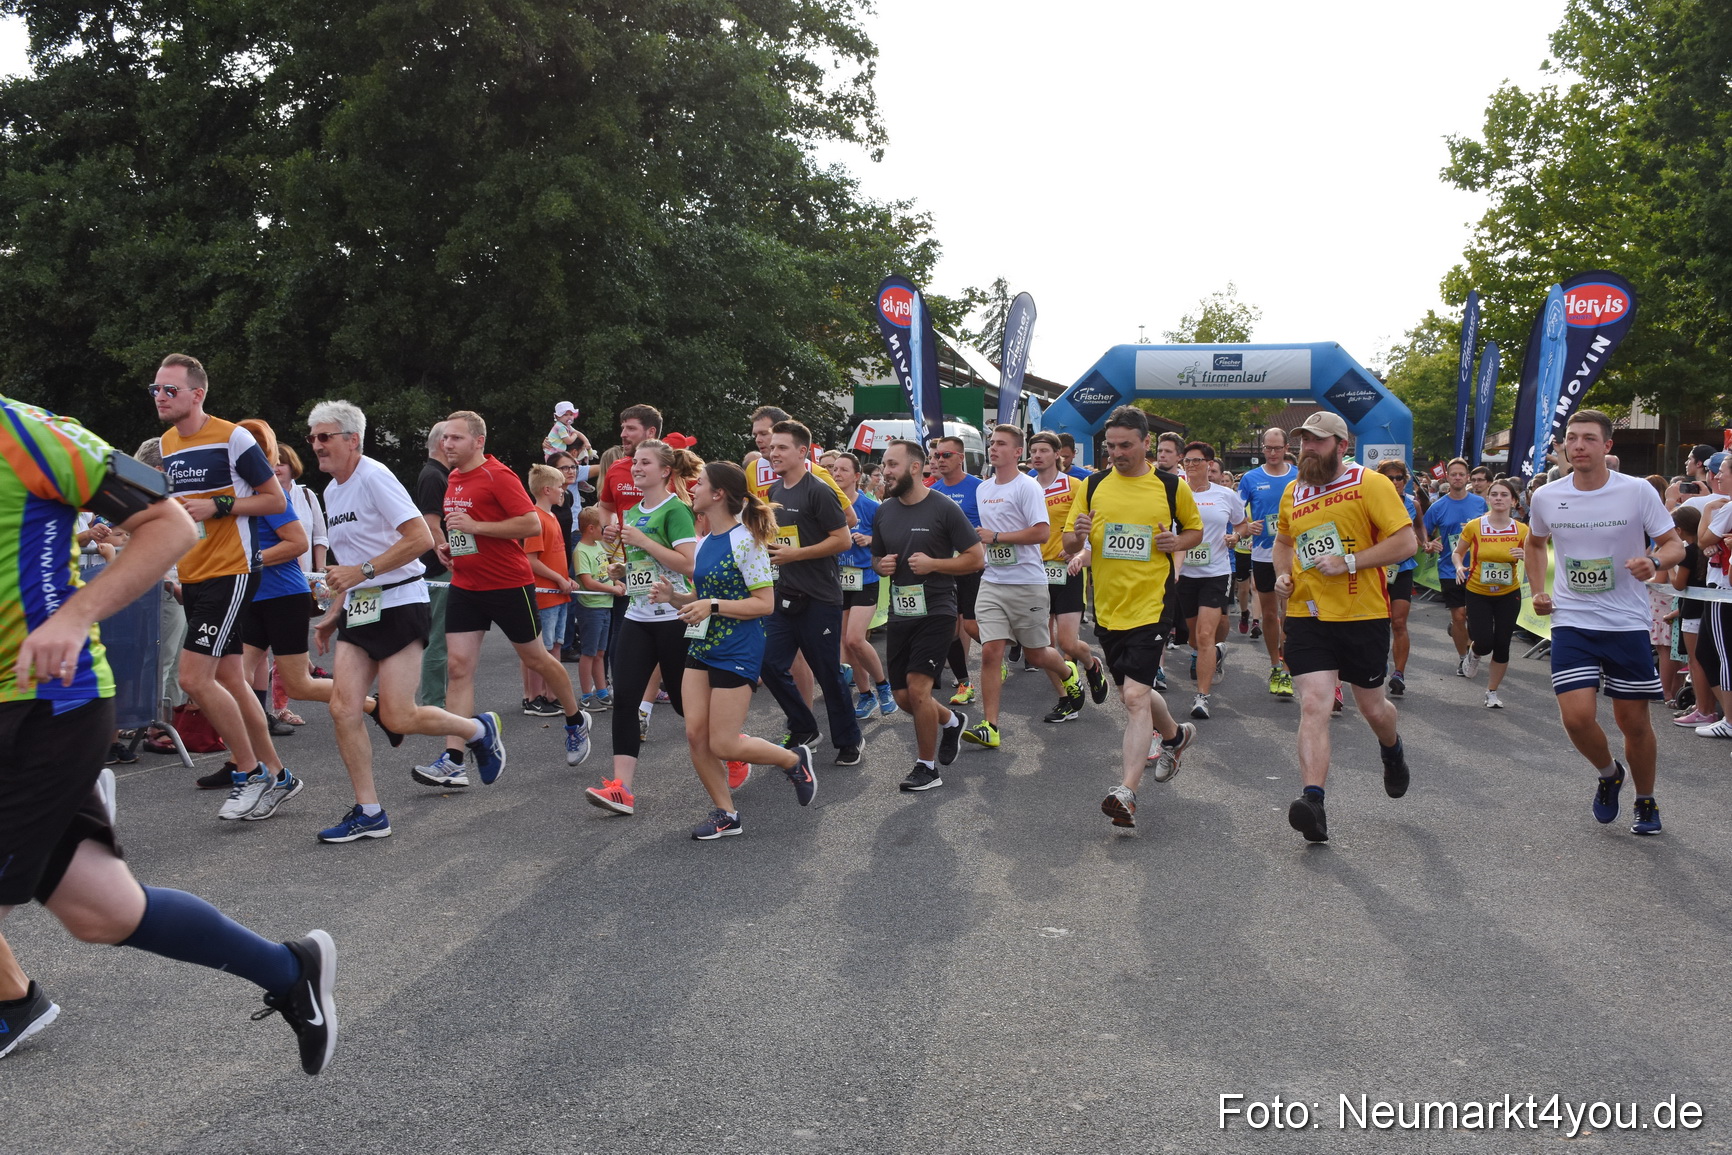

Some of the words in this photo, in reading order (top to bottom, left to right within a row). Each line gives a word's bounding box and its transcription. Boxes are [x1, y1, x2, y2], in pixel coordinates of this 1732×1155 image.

[1563, 294, 1624, 318] Hervis
[1202, 370, 1268, 383] firmenlauf
[1080, 393, 1115, 401] Fischer
[171, 467, 209, 479] Fischer
[1047, 495, 1073, 506] BÖGL
[1292, 502, 1320, 520] MAX
[1324, 490, 1362, 507] BÖGL
[329, 511, 358, 528] MAGNA
[1593, 520, 1628, 528] HOLZBAU
[1108, 535, 1145, 551] 2009
[1302, 536, 1335, 559] 1639
[988, 548, 1011, 559] 1188
[627, 571, 653, 586] 1362
[1484, 570, 1509, 579] 1615
[1570, 570, 1608, 584] 2094
[348, 599, 377, 617] 2434
[897, 596, 916, 608] 158
[198, 622, 218, 636] AO
